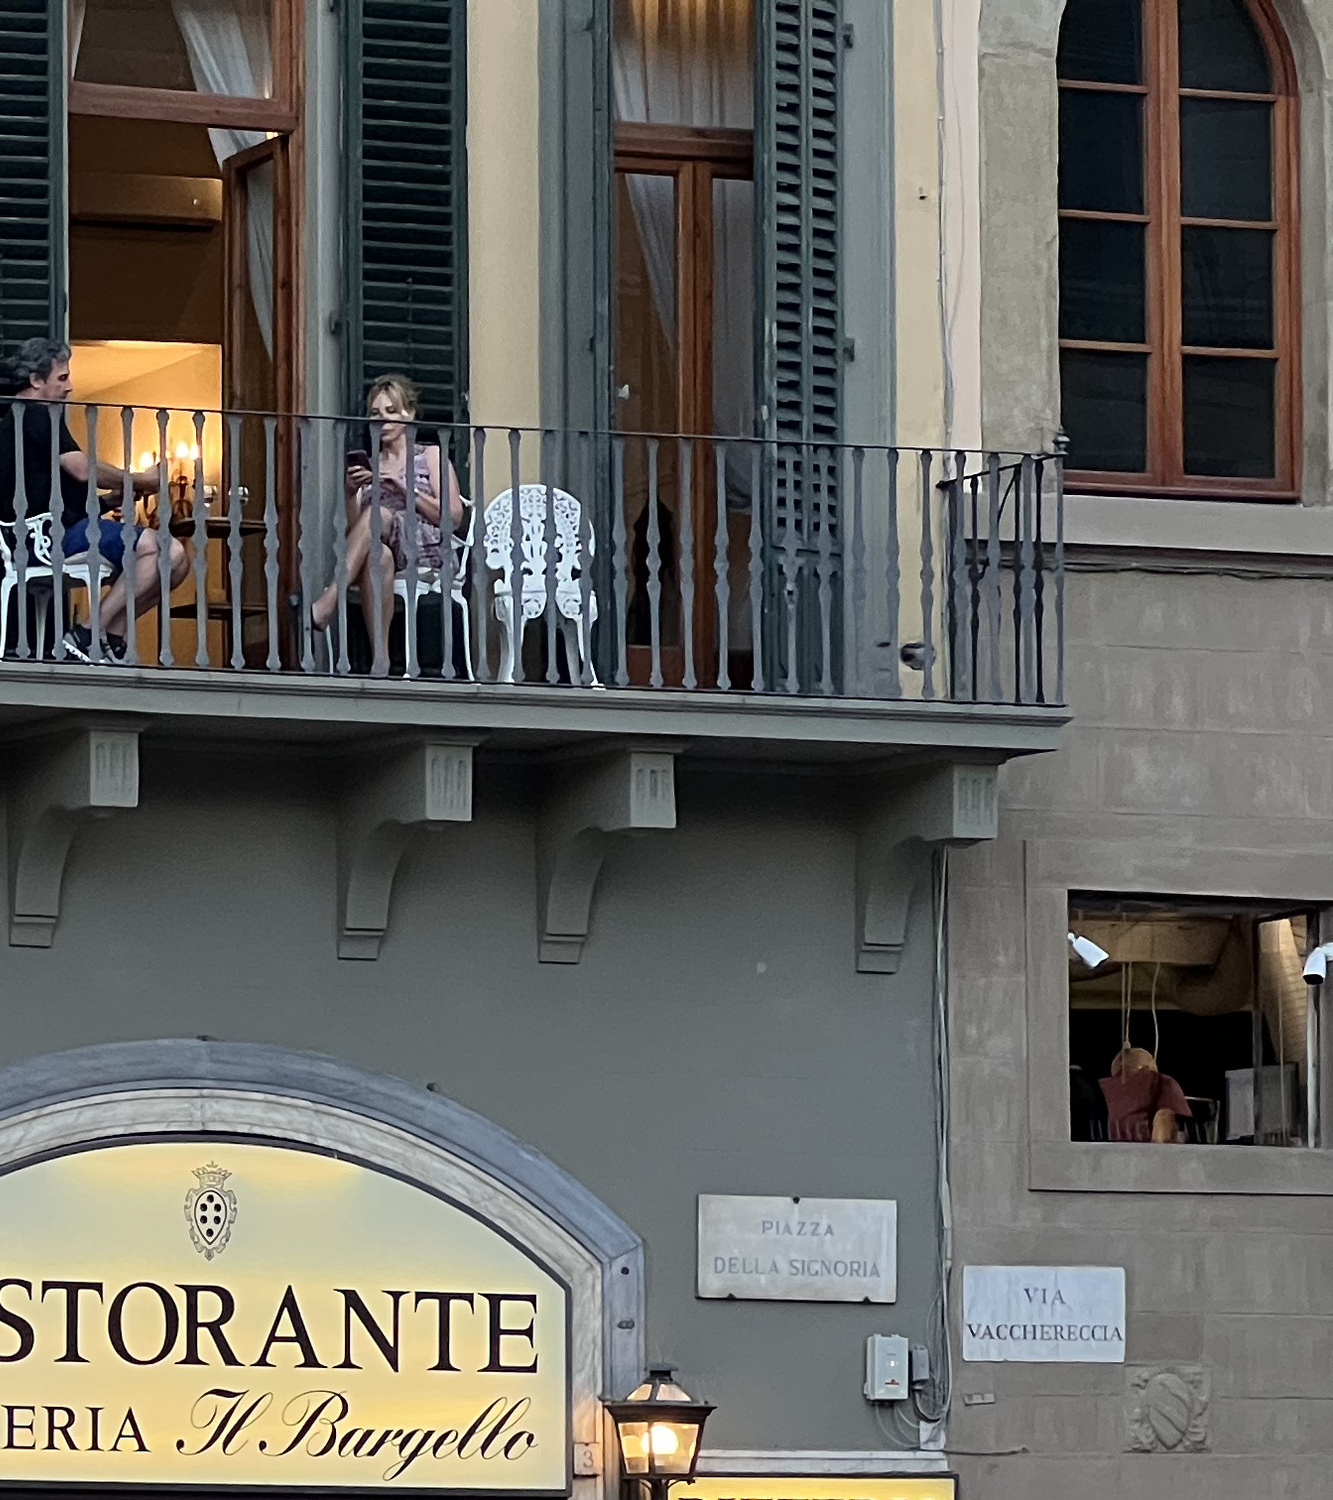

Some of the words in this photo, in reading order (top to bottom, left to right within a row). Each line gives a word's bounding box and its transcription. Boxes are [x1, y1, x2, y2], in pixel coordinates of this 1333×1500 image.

[761, 1220, 835, 1238] PIAZZA
[713, 1256, 780, 1276] DELLA
[788, 1258, 882, 1279] SIGNORIA
[1023, 1287, 1067, 1306] VIA
[965, 1322, 1124, 1344] VACCHERECCIA
[259, 1390, 539, 1481] Bargello
[583, 1450, 594, 1468] 3
